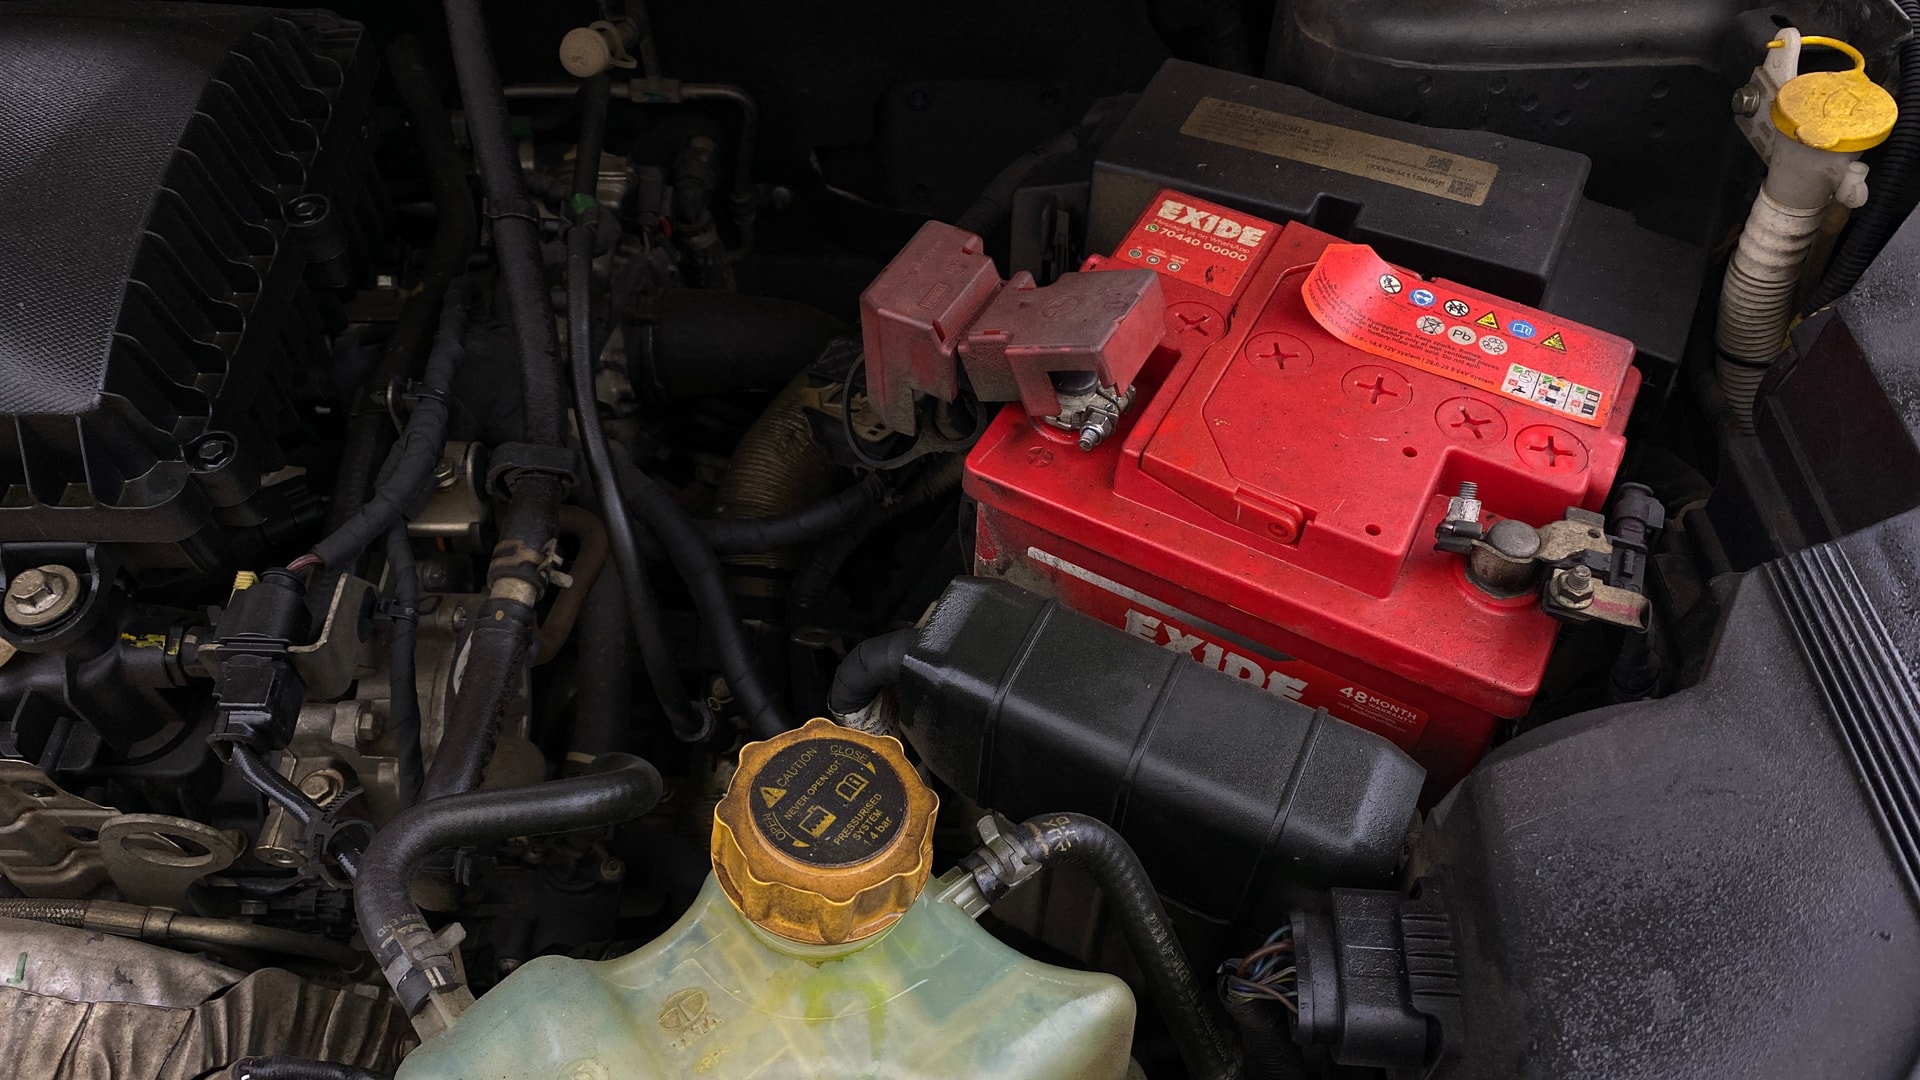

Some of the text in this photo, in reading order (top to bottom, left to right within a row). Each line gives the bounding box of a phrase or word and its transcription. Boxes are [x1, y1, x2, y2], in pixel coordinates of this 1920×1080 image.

[1156, 199, 1266, 247] EXIDE
[1159, 228, 1200, 246] 70440
[1203, 242, 1248, 262] 00000
[1383, 345, 1397, 353] 12V
[1452, 329, 1472, 341] Pb
[1124, 608, 1309, 701] EXIDE
[1339, 686, 1417, 720] 48 MONTH
[776, 746, 818, 788] CAUTION
[830, 744, 869, 763] CLOSE
[783, 759, 842, 820] NEVER OPEN HOT
[763, 812, 786, 842] OPEN
[833, 793, 883, 846] PRESSURISED
[852, 809, 883, 841] SYSTEM
[876, 816, 893, 834] bar
